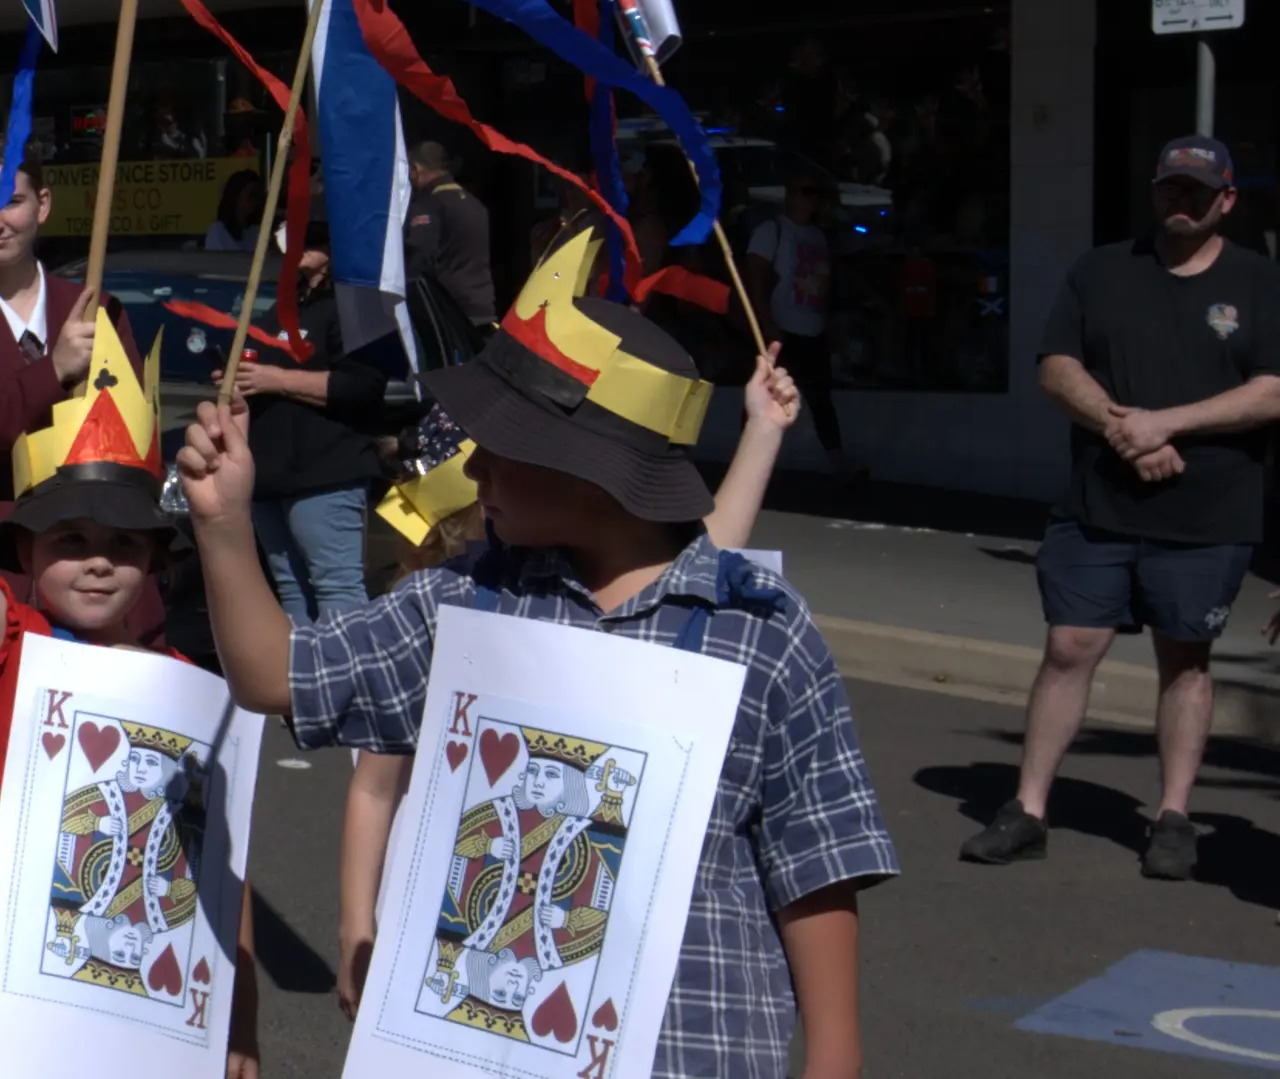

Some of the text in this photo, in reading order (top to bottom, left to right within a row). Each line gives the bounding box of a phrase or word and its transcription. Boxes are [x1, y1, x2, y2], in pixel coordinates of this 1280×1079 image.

[159, 161, 216, 183] STORE
[149, 214, 182, 232] GIFT
[43, 688, 73, 730] K
[449, 691, 478, 738] K
